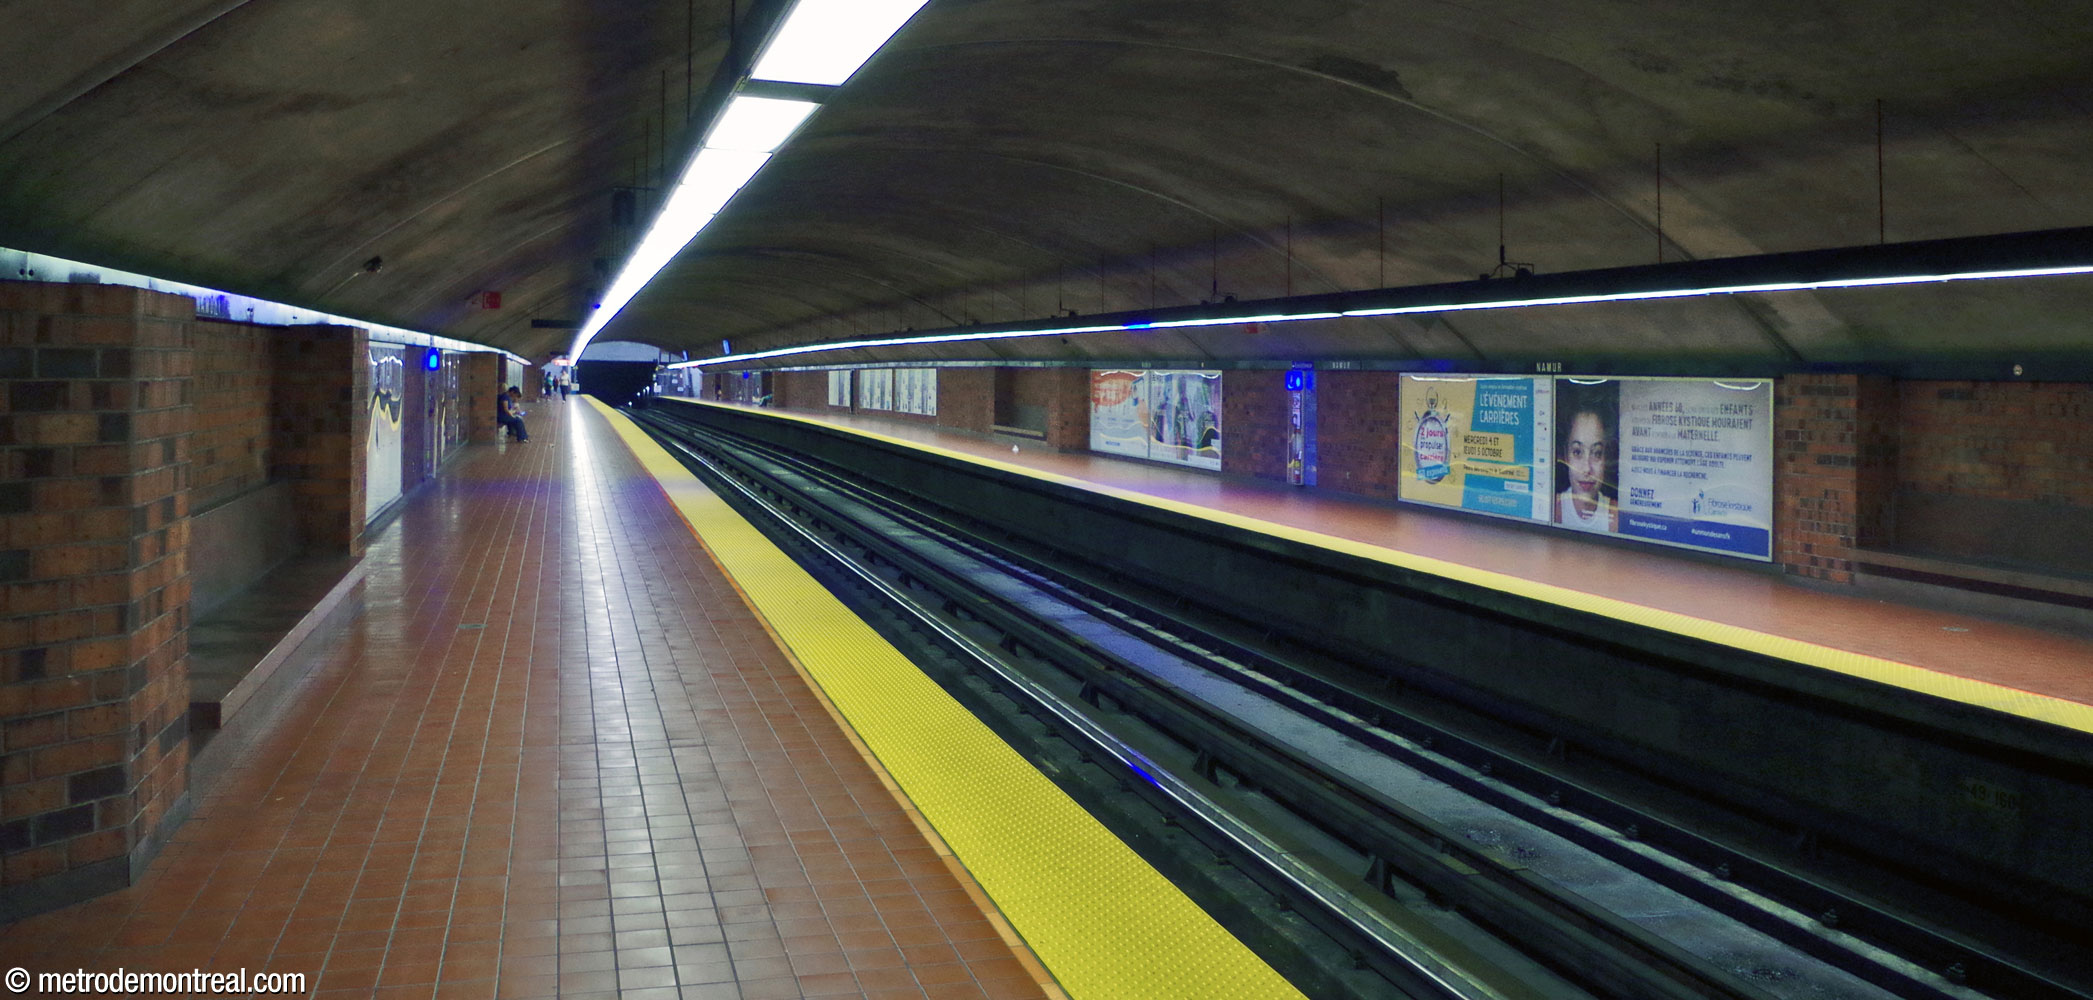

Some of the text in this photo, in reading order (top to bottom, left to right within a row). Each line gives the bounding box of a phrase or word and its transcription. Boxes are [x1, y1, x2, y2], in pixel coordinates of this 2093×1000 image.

[1536, 362, 1562, 372] NAMUR
[1480, 391, 1528, 408] L'ÉVÉNEMENT
[1649, 400, 1673, 412] ANNÉES
[1720, 403, 1753, 416] ENFANTS
[1480, 408, 1520, 425] CARRIÈRES
[1652, 414, 1677, 426] FIBROSE
[1678, 415, 1711, 427] KYSTIQUE
[1712, 417, 1753, 430] MOURAIENT
[1421, 427, 1444, 438] 2 jours
[1632, 426, 1651, 437] AVANT
[1464, 435, 1488, 445] MERCREDI
[1494, 437, 1499, 446] ET
[1482, 447, 1503, 458] OCTOBRE
[1631, 487, 1654, 499] DONNEZ
